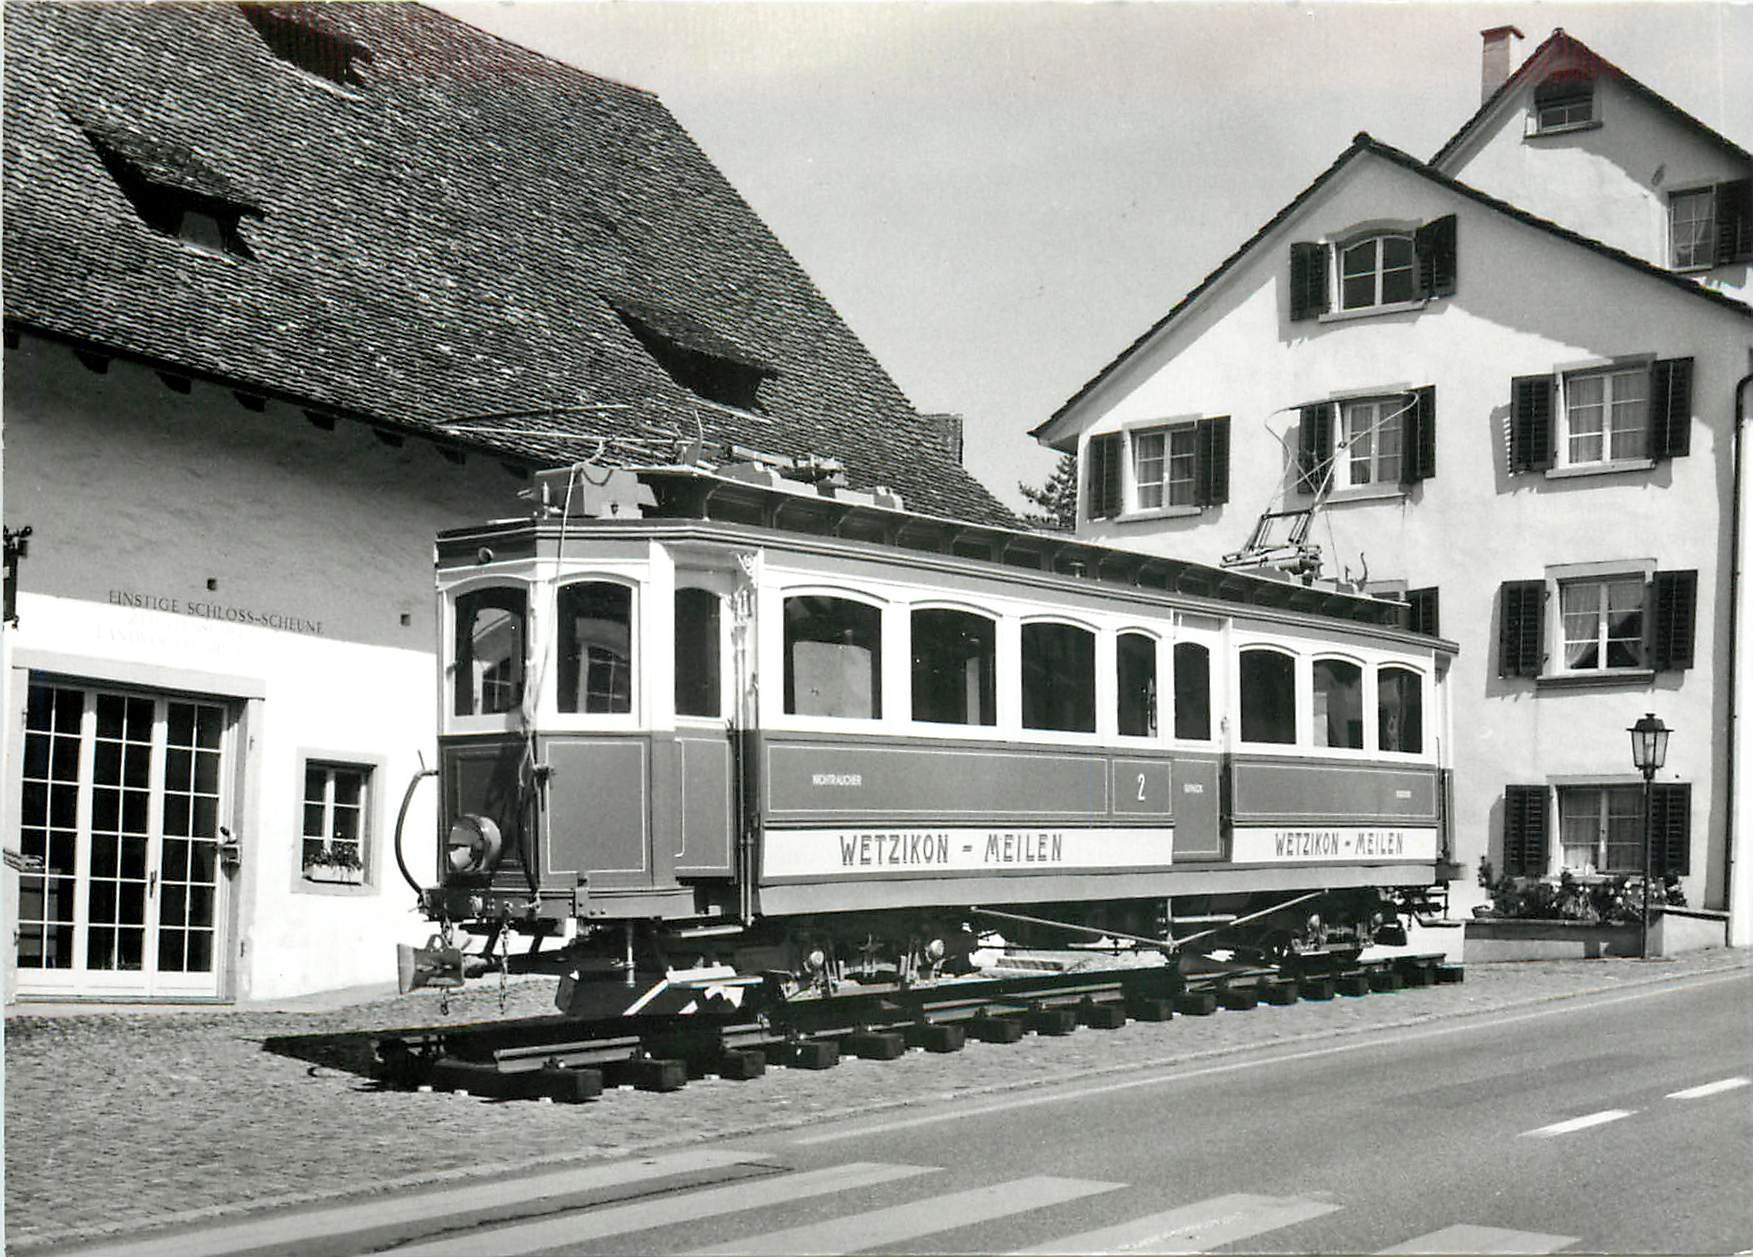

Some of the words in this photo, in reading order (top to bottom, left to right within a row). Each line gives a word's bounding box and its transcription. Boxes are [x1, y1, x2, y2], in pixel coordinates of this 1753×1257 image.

[109, 590, 179, 613] EINSTIGE
[188, 602, 325, 634] SCHLOSS-SCHEUNE
[1138, 773, 1146, 801] 2
[840, 834, 949, 865] WETZIKON
[984, 834, 1063, 862] MEILEN
[1275, 832, 1339, 856] WETZIKON
[1355, 832, 1403, 855] MEILEN
